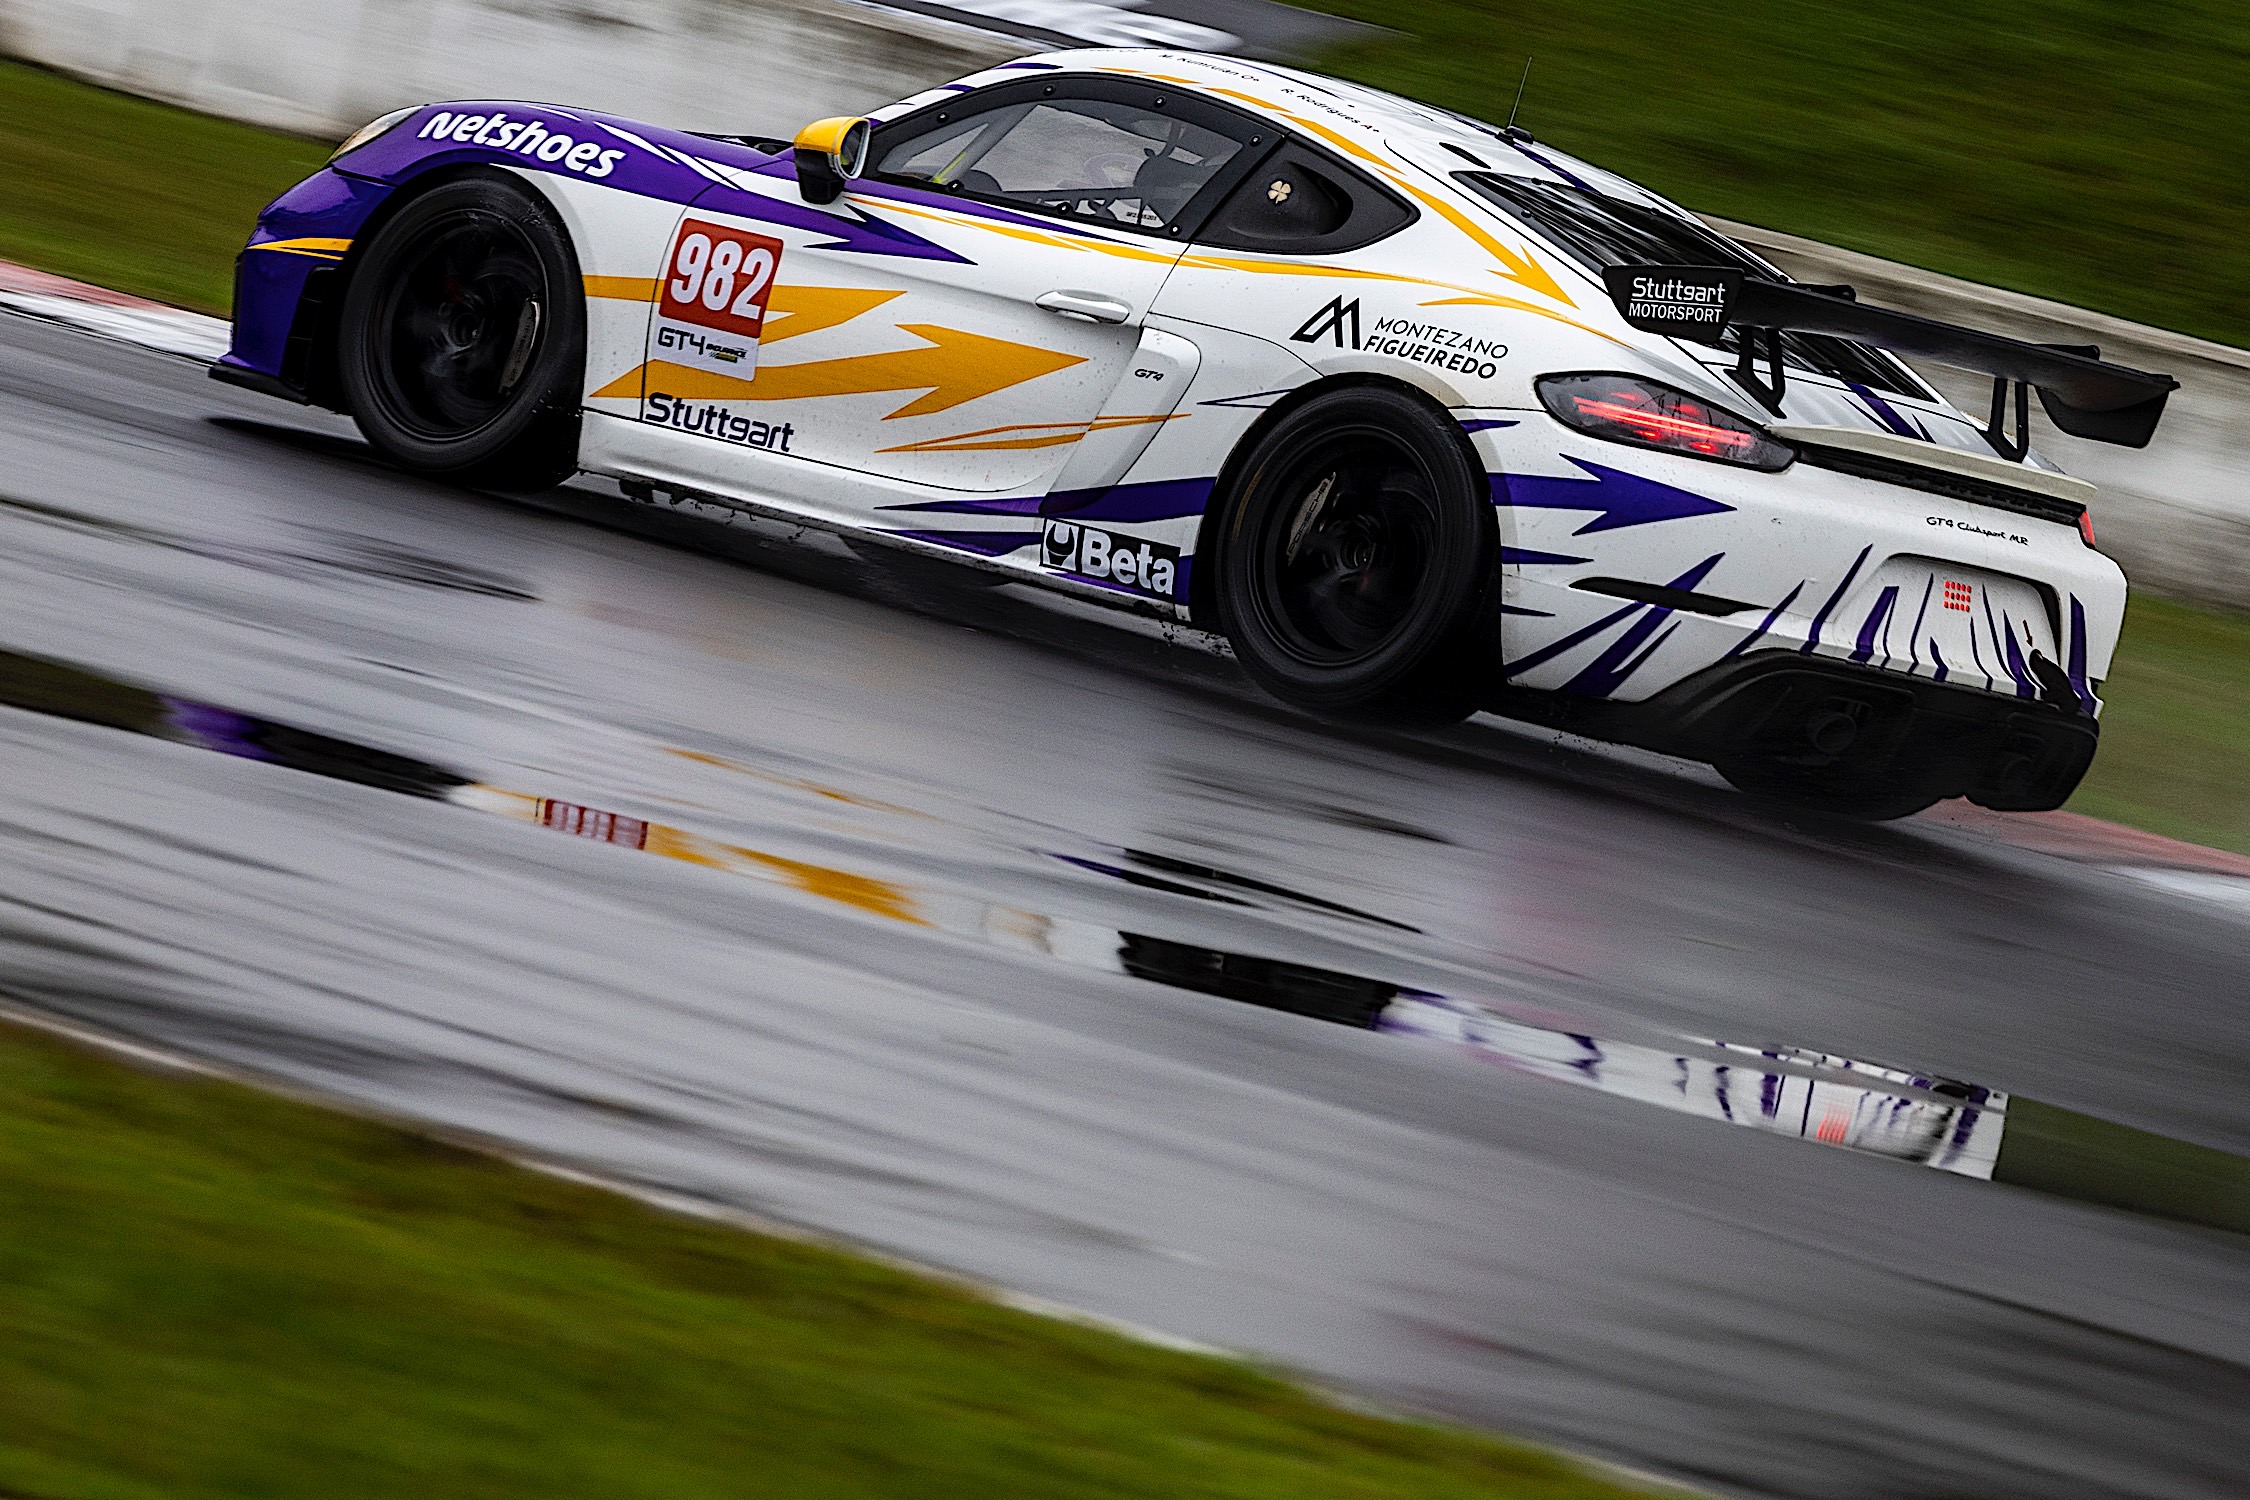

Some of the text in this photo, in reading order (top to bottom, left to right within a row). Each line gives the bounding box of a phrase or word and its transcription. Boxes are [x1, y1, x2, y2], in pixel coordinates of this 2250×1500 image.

[1296, 94, 1361, 124] Rodrigues
[417, 111, 627, 178] Netshoes
[671, 232, 774, 320] 982
[1631, 276, 1726, 304] Stuttgart
[1628, 302, 1723, 323] MOTORSPORT
[658, 326, 706, 356] GT4
[1363, 335, 1498, 379] FIGUEIREDO
[1374, 316, 1509, 360] MONTEZANO
[1134, 368, 1165, 382] GT4
[645, 391, 795, 453] Stuttgart
[1287, 481, 1329, 555] PORSCHE
[1926, 516, 1954, 529] GT4
[1957, 521, 2007, 540] Clubsport
[1081, 527, 1175, 596] Beta
